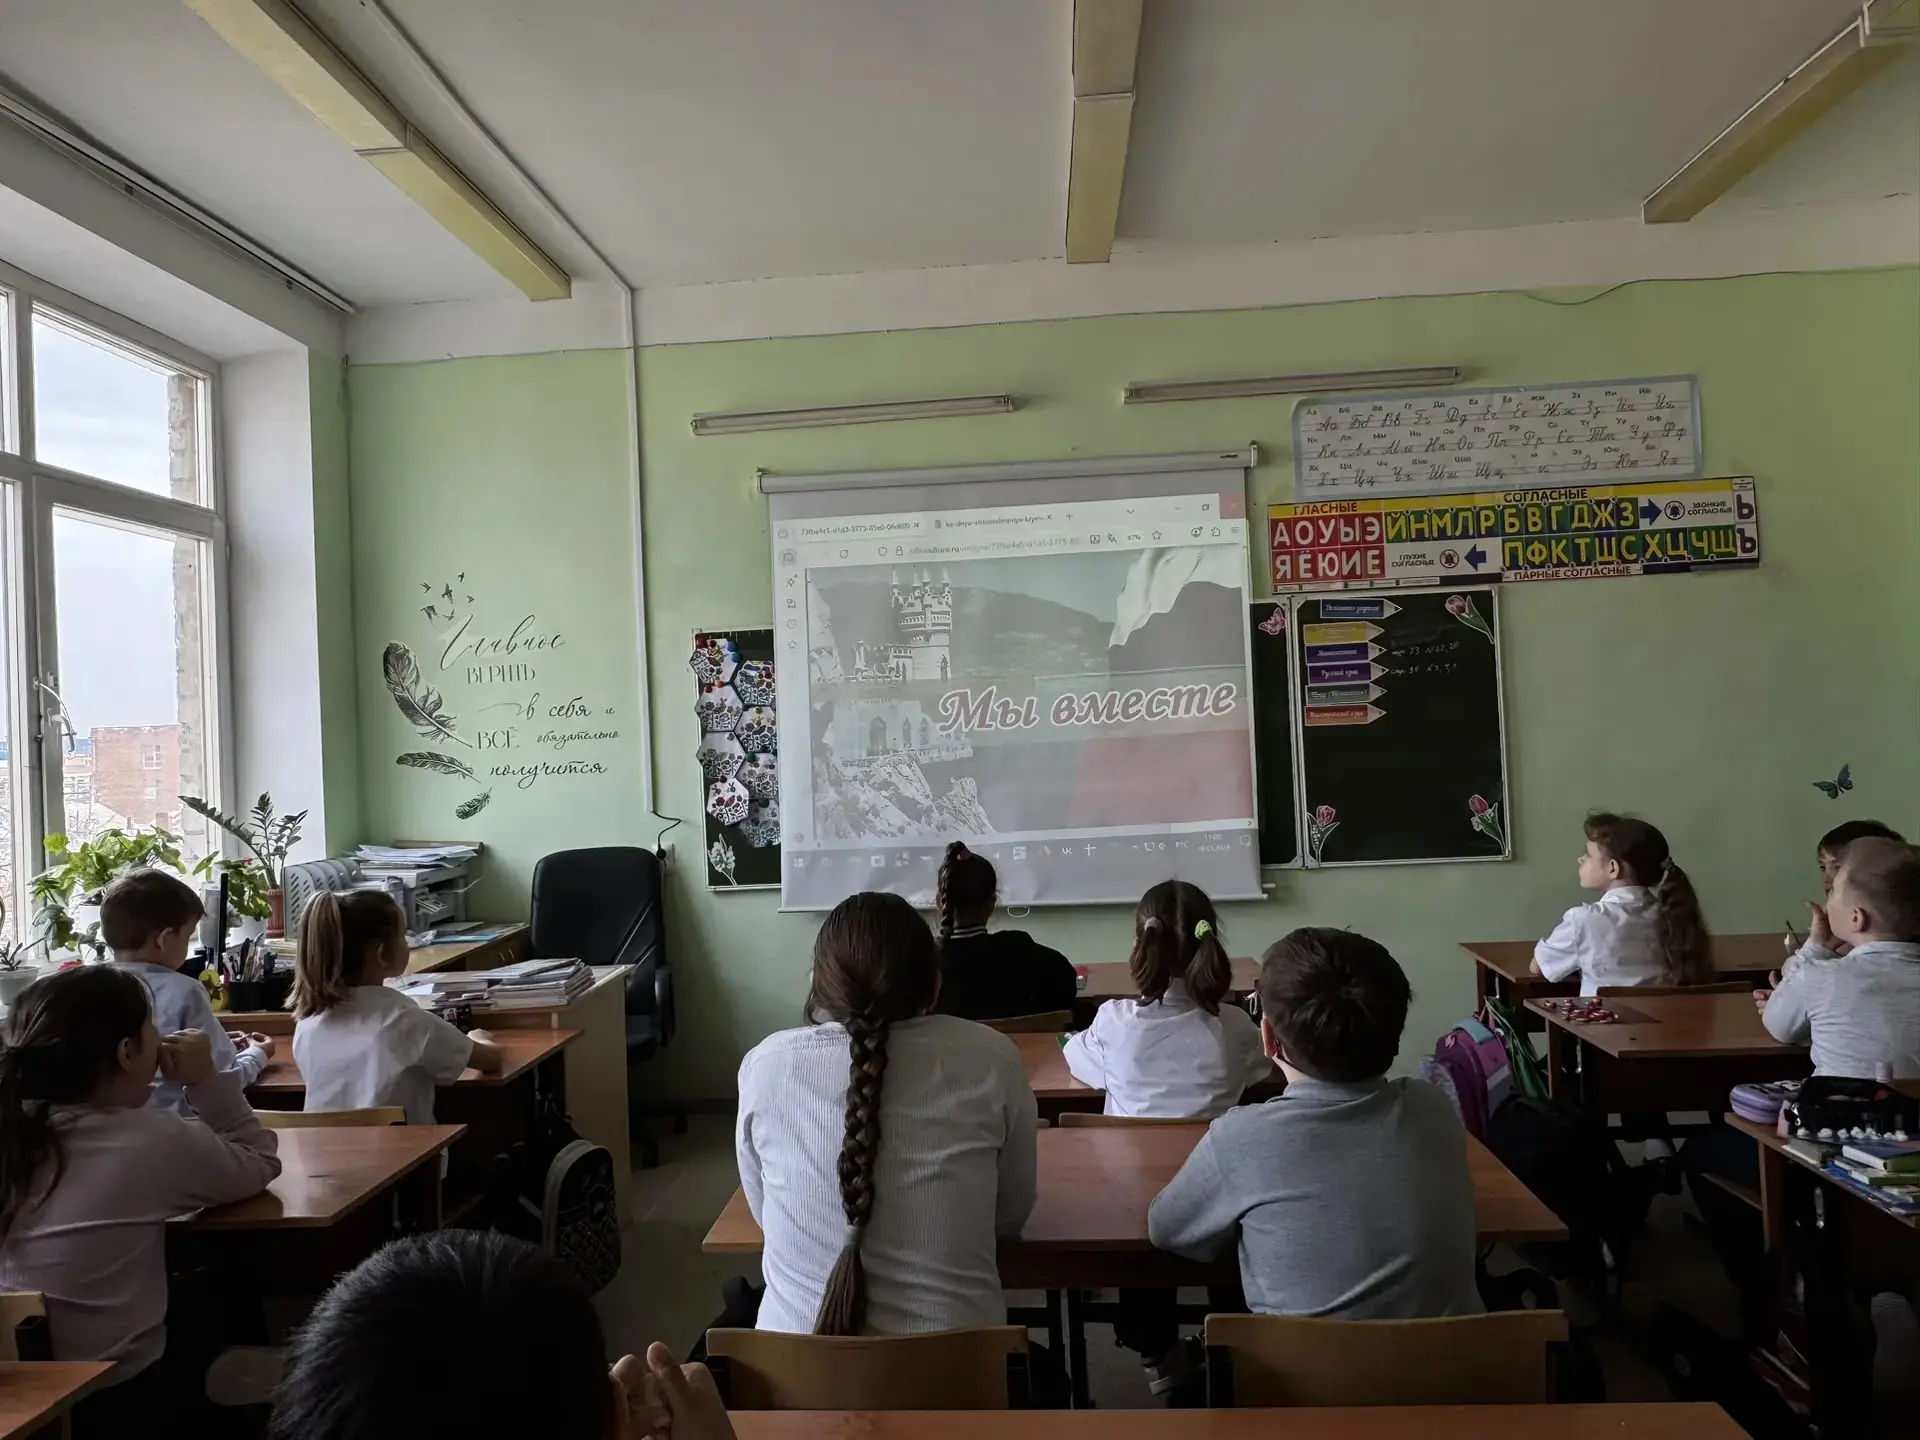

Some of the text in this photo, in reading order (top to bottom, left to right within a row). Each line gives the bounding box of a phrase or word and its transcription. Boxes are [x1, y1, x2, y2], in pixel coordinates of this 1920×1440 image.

[1504, 488, 1588, 503] СОГЛАСНЫЕ
[1736, 494, 1754, 519] Ь
[1294, 502, 1358, 516] ГЛАСНЫЕ
[1736, 528, 1756, 553] Ъ
[1514, 565, 1631, 580] ПАРНЫЕ СОГЛАСНЫЕ
[440, 614, 566, 670] Главное
[466, 664, 536, 684] ВЕРИТЬ
[549, 696, 592, 718] себя
[938, 682, 1236, 733] Мы вместе
[537, 730, 620, 750] обязательно
[490, 761, 608, 789] получится
